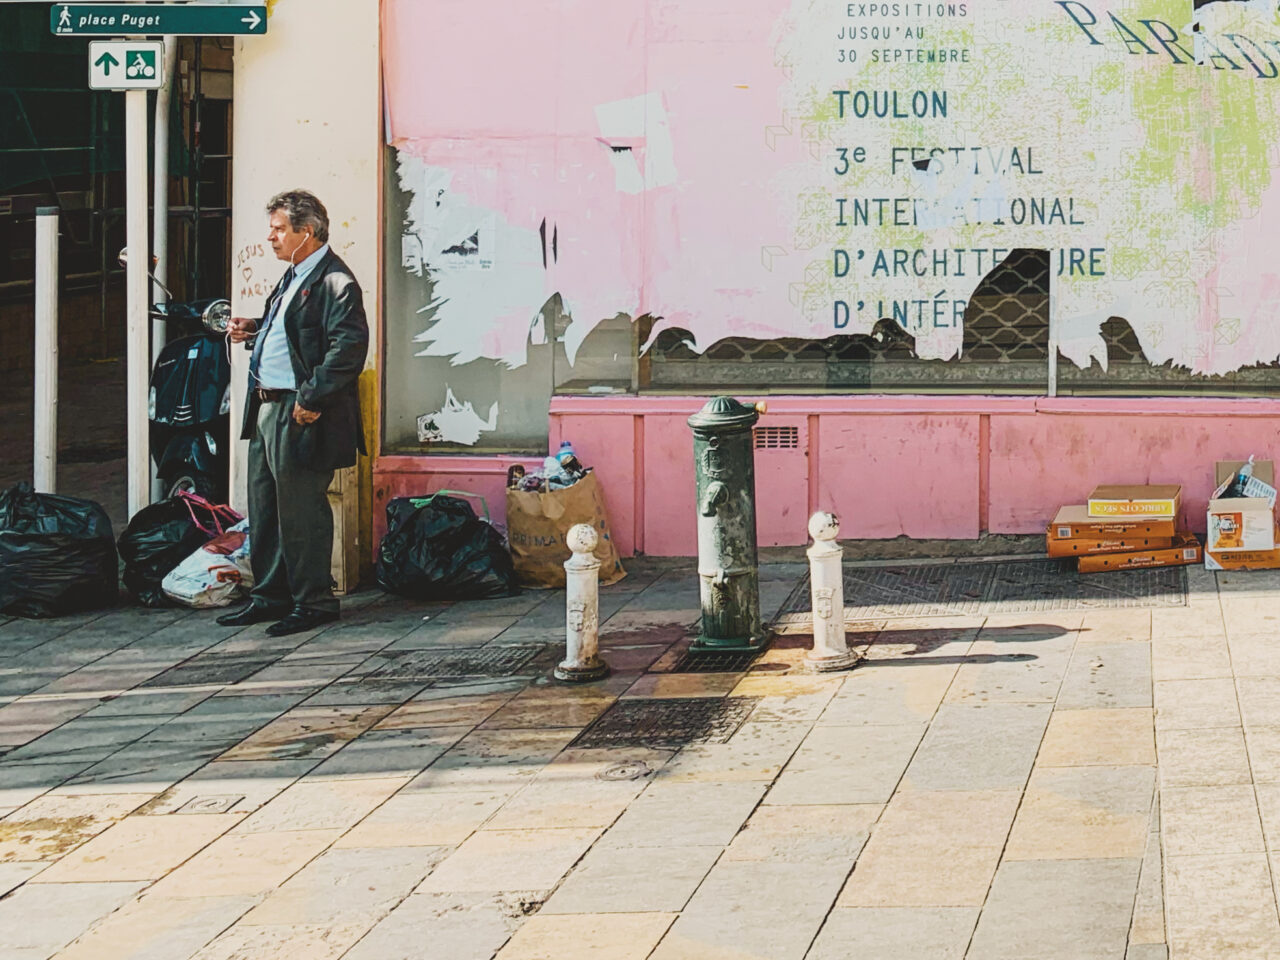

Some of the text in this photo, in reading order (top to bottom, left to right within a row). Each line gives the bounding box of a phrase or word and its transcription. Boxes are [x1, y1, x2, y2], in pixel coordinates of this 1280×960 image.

[847, 3, 968, 17] EXPOSITIONS
[79, 14, 160, 29] place Puget
[837, 26, 925, 40] JUSQU'AU
[837, 49, 970, 63] 30 SEPTEMBRE
[832, 90, 948, 119] TOULON
[835, 197, 1085, 227] INTETIONAL
[237, 243, 265, 269] JESUS
[834, 247, 1106, 277] D'ARCHITERE
